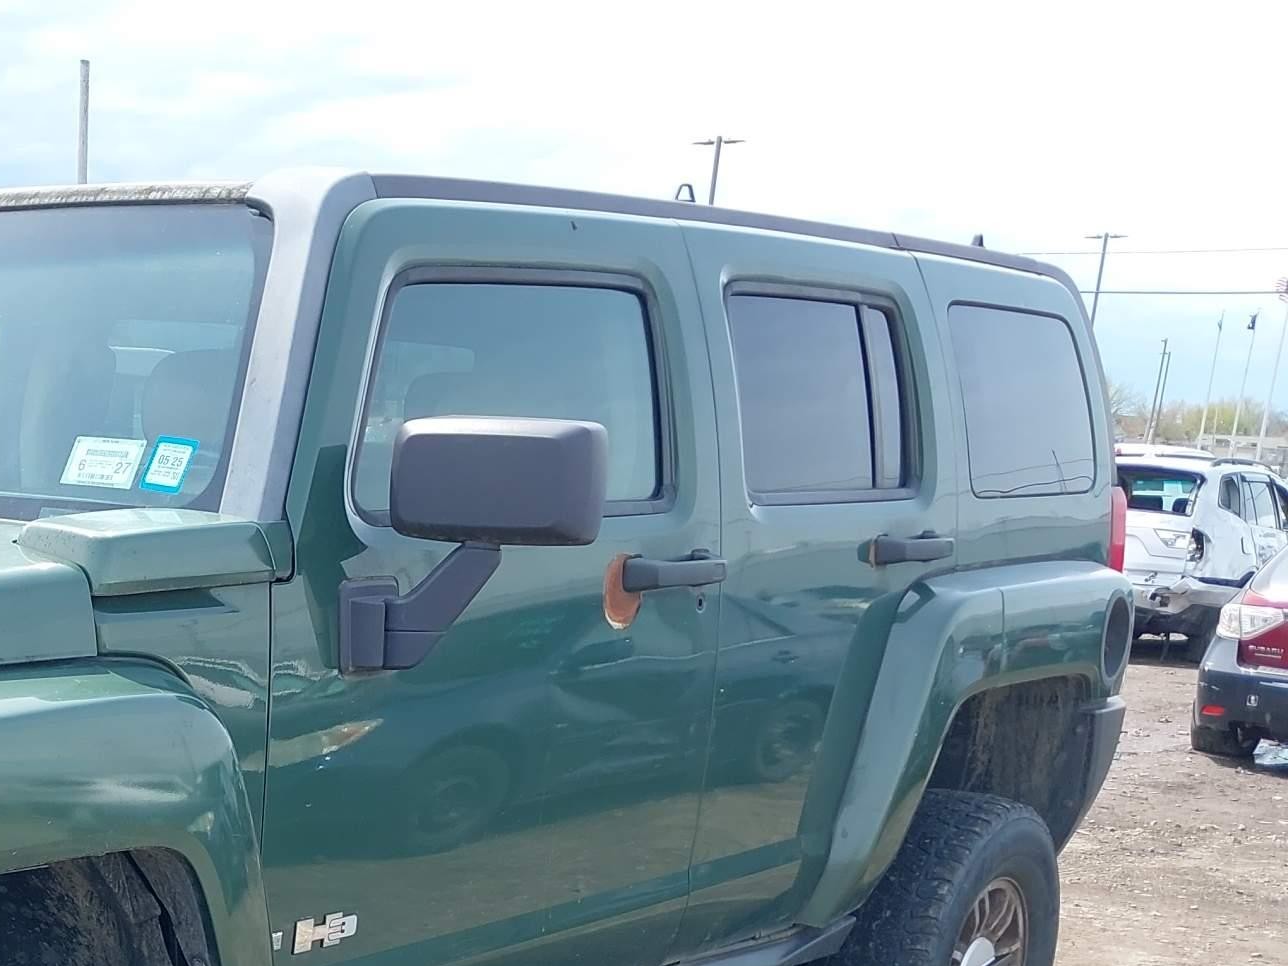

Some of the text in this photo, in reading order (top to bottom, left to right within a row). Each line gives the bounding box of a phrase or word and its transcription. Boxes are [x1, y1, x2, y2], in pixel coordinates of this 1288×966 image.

[78, 458, 87, 471] 6
[113, 461, 133, 475] 27
[291, 911, 358, 955] H3
